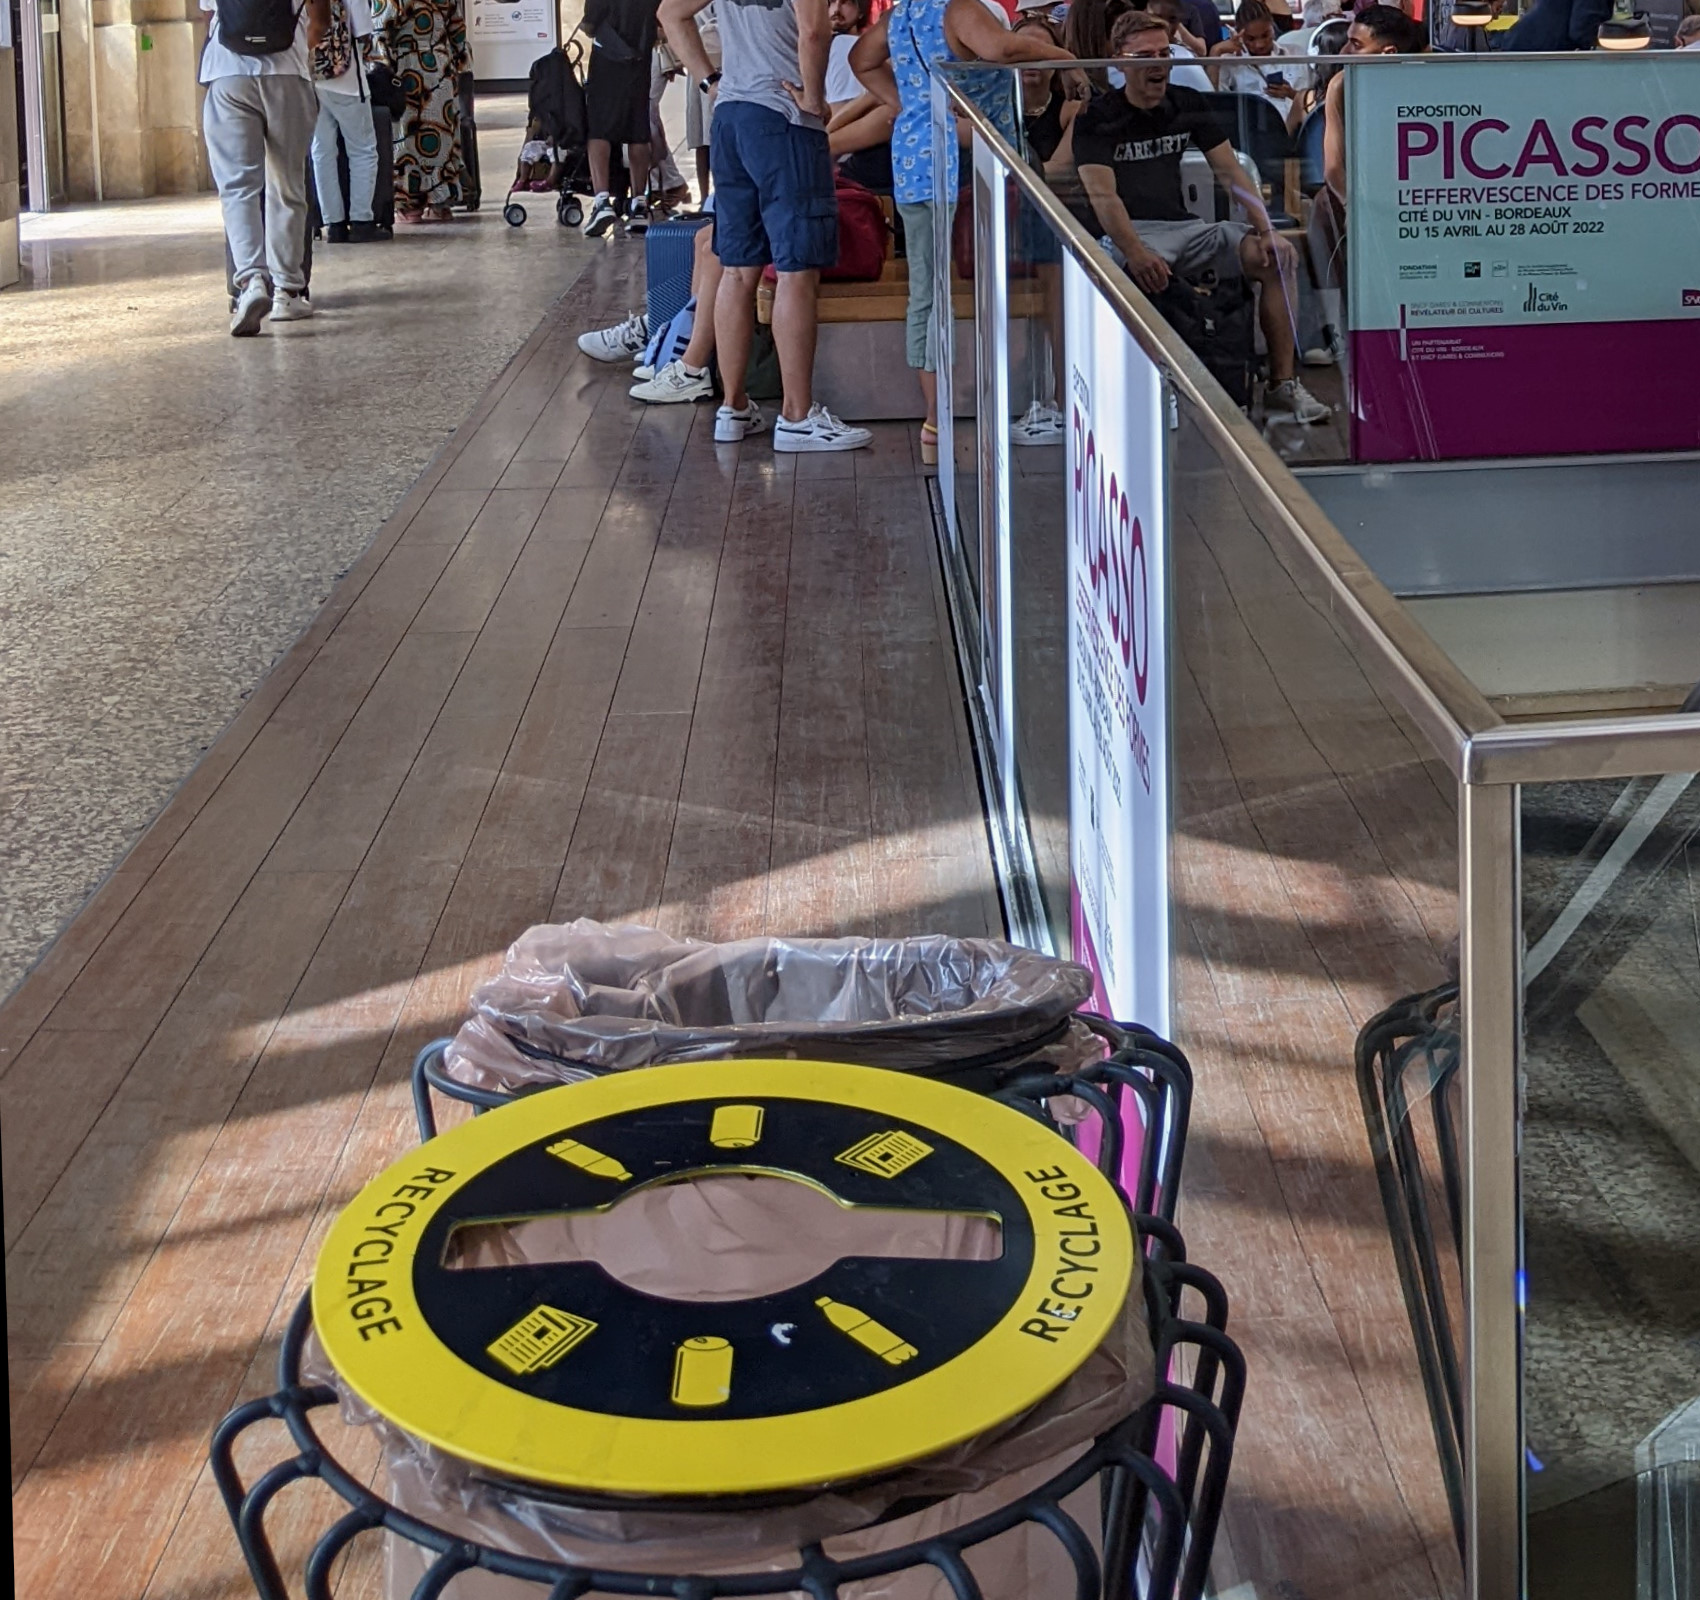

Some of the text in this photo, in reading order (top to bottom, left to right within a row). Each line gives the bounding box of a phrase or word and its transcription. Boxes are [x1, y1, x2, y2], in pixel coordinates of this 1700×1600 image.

[1397, 104, 1482, 118] EXPOSITION
[1398, 185, 1579, 206] L'EFFERVESCENCE
[1585, 183, 1624, 201] DES
[1398, 208, 1429, 223] CITÉ
[1432, 211, 1453, 222] DU
[1458, 209, 1482, 221] VIN
[1494, 206, 1572, 220] BORDEAUX
[1399, 219, 1605, 239] DU 15 AVRIL AU 28 AOÛT 2022
[1538, 291, 1560, 301] Cité
[1468, 306, 1504, 314] CULTURES
[1537, 302, 1568, 312] du Vin
[1074, 401, 1149, 706] PICASSO
[345, 1165, 456, 1343] RECYCLAGE
[1019, 1163, 1105, 1345] RECYCLAGE
